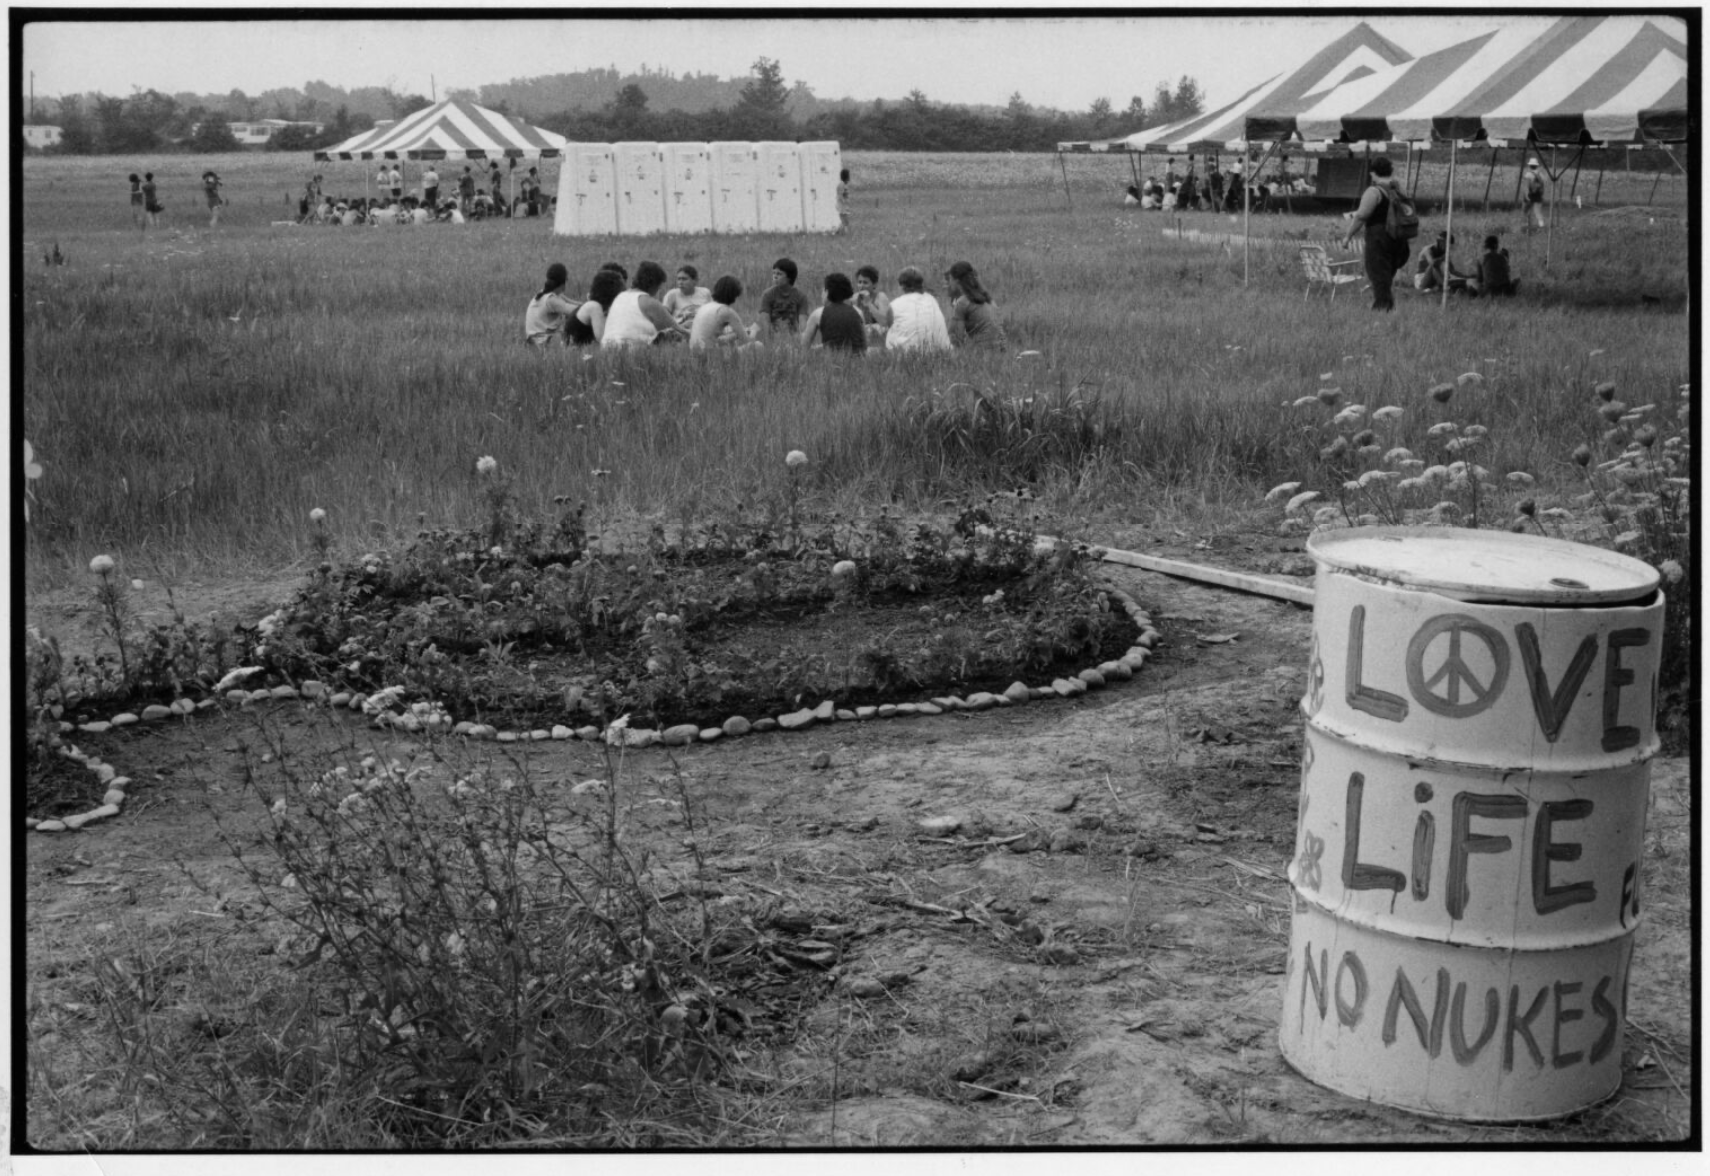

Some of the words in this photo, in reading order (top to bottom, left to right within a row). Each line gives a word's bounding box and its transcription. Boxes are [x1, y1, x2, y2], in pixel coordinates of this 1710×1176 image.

[1345, 605, 1650, 752] LOVE
[1300, 941, 1368, 1033] NO
[1382, 967, 1618, 1071] NUKES
